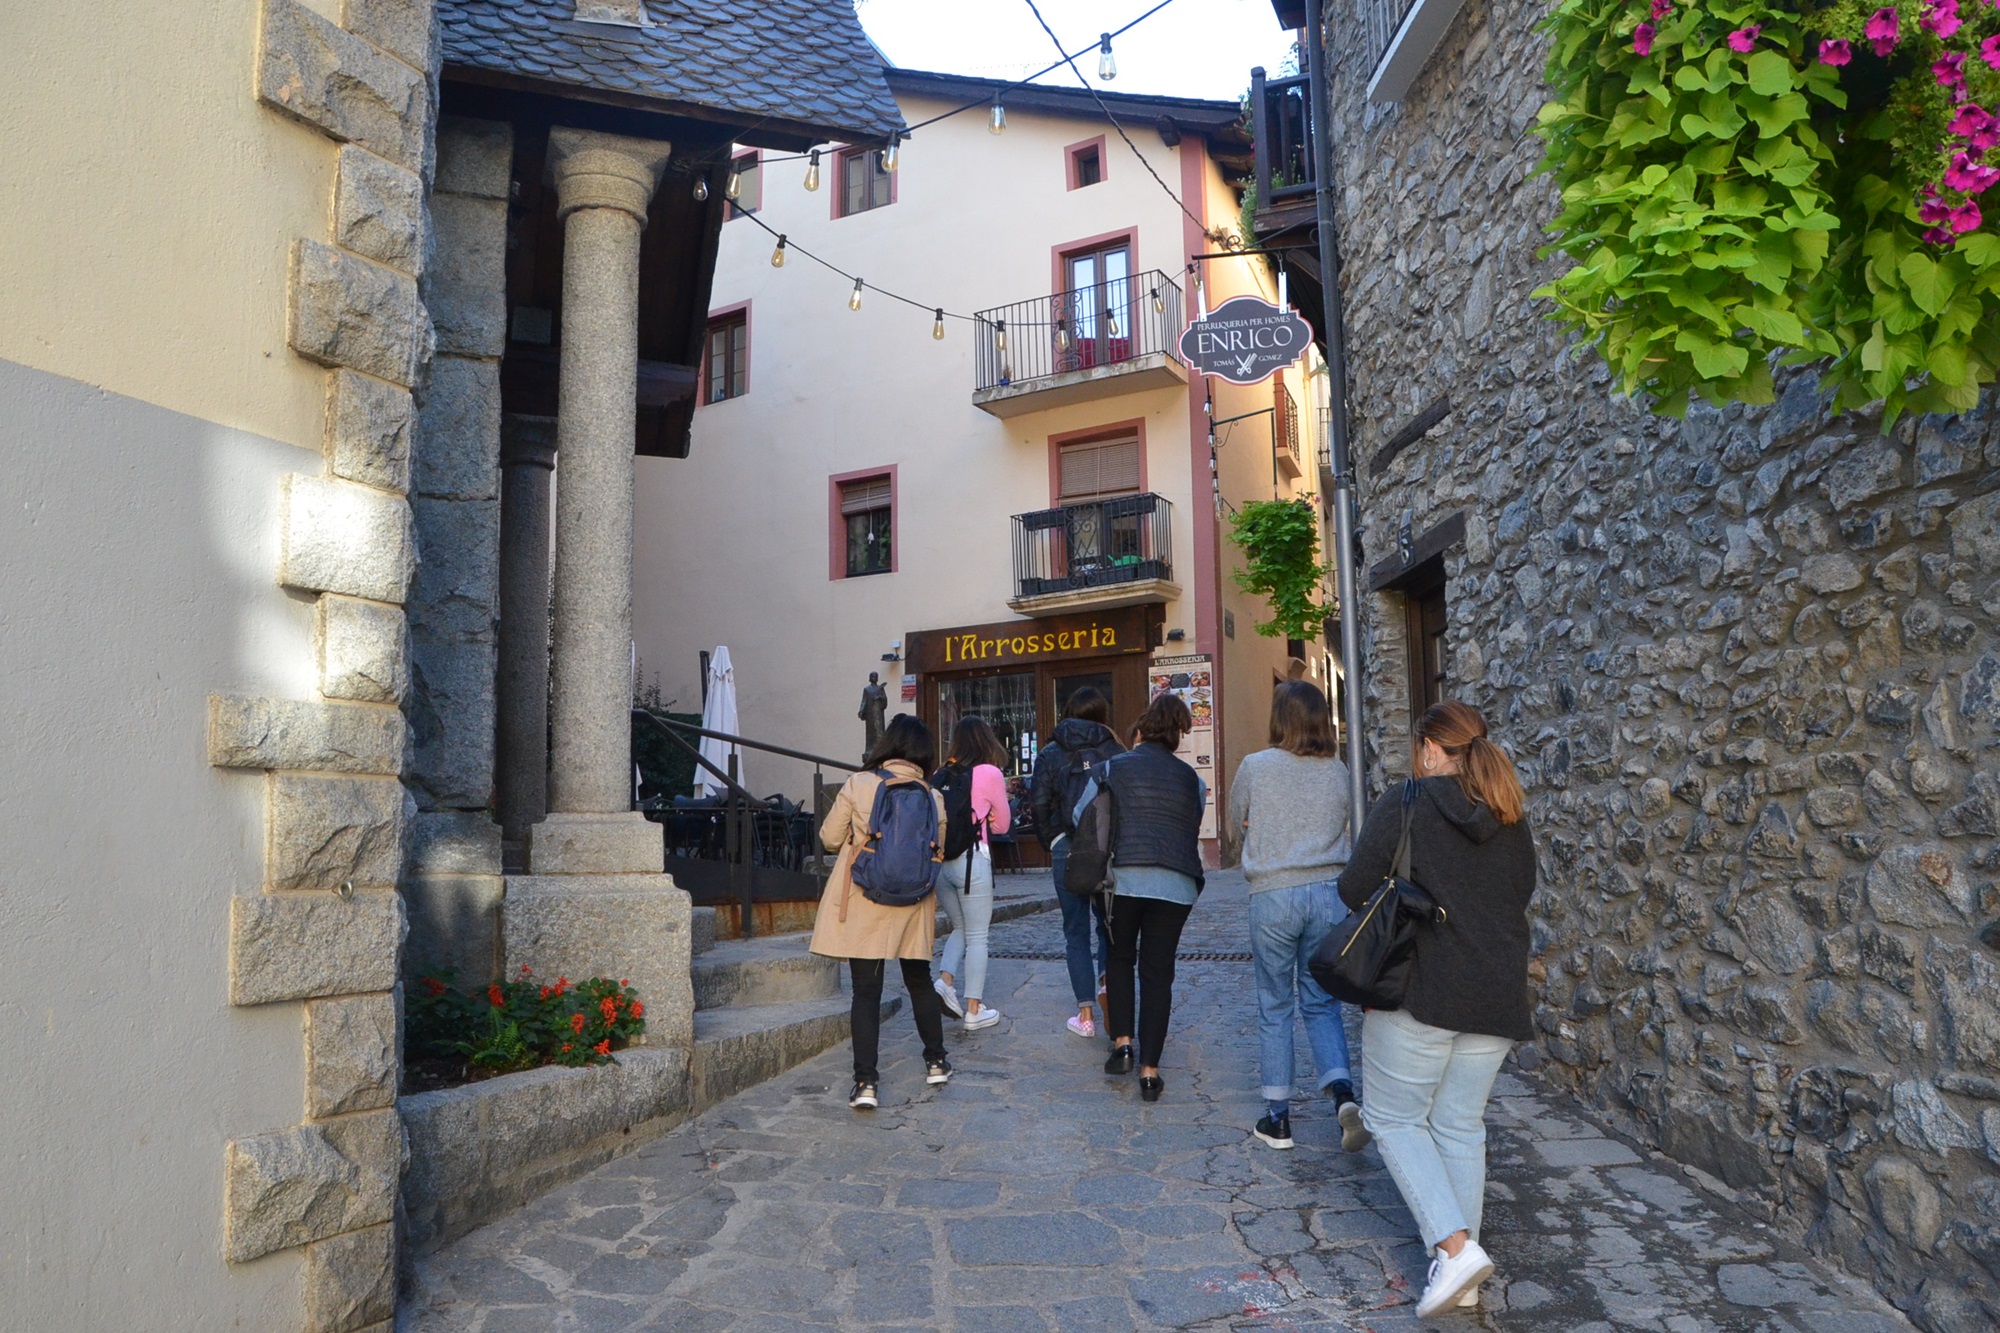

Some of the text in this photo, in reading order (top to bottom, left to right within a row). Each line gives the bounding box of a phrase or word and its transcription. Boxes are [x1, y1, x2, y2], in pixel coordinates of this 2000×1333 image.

[1197, 315, 1291, 331] PERRUQUERIA PER HOMES
[1197, 325, 1293, 354] ENRICO
[1258, 354, 1283, 362] GOMEZ
[945, 622, 1117, 662] l'Arrosseria
